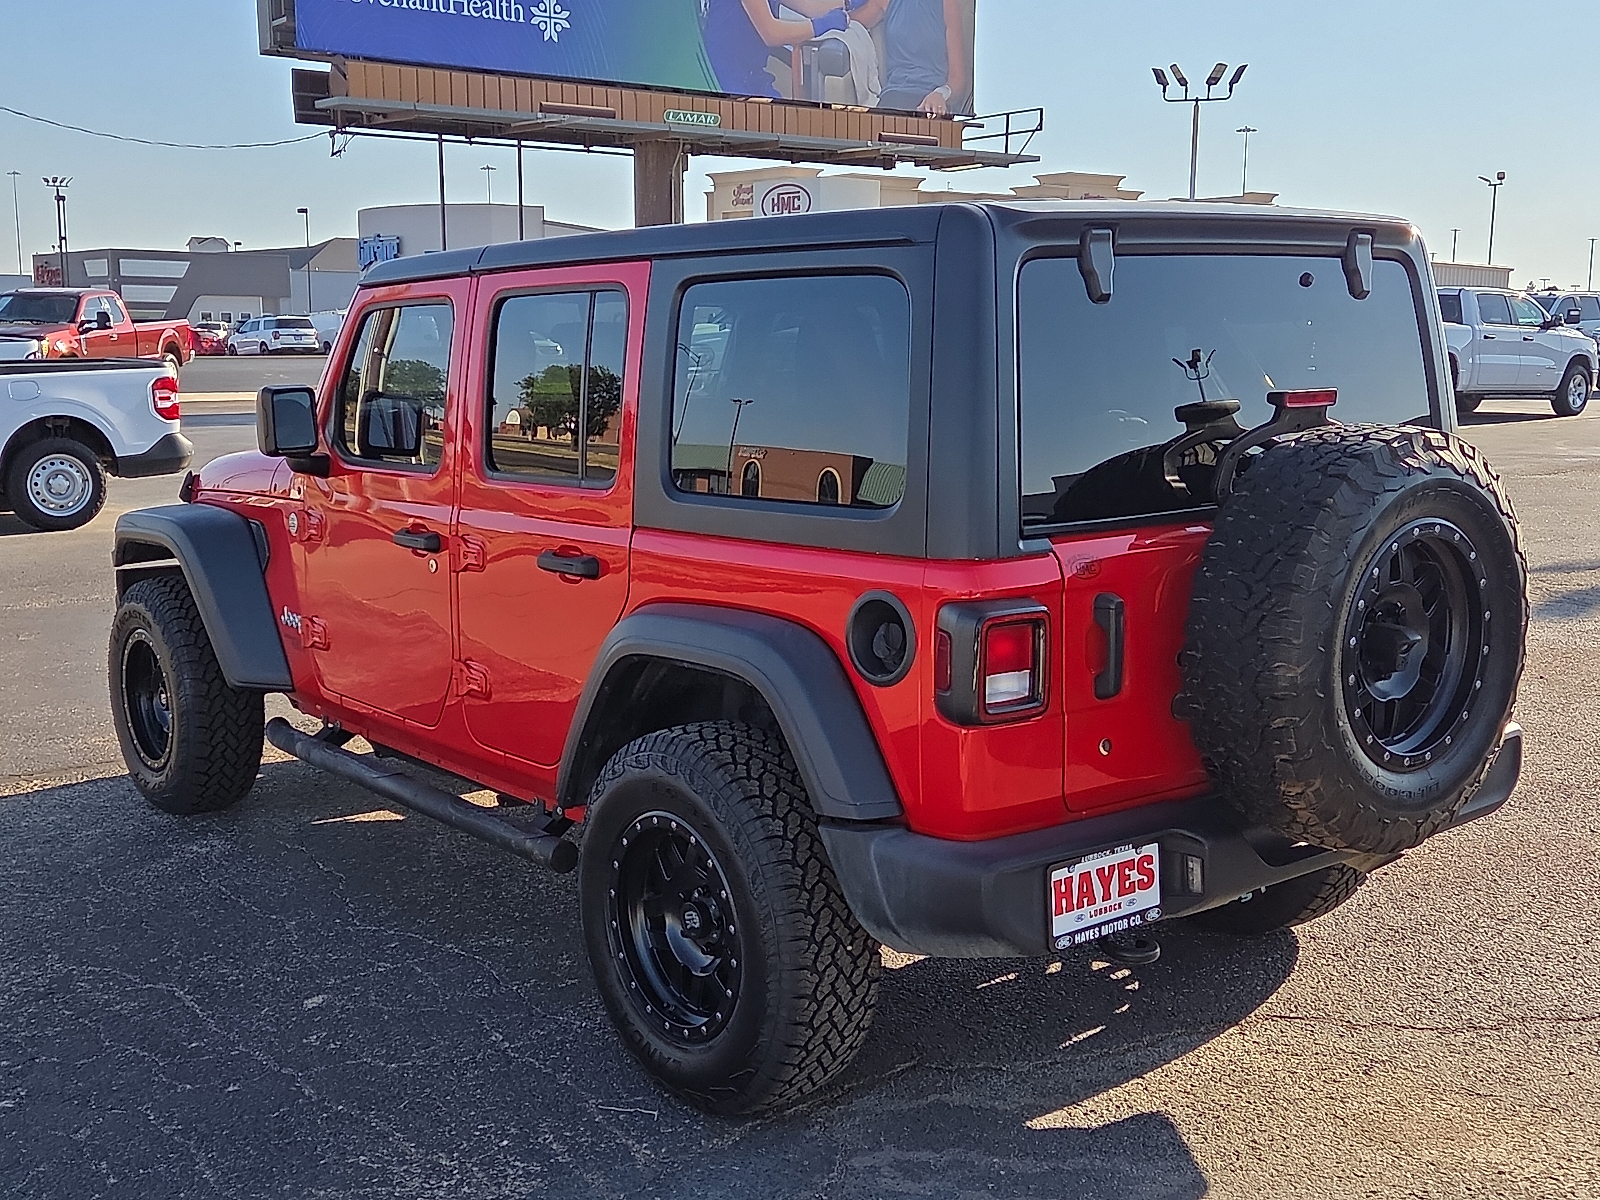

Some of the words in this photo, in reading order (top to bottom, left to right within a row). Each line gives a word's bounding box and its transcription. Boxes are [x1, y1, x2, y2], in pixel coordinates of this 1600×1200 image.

[668, 111, 715, 124] LAMAR
[770, 190, 801, 215] HMC
[1114, 843, 1133, 854] TEXAS
[1053, 853, 1156, 917] HAYES
[1088, 902, 1123, 919] LUBBOCK
[1074, 927, 1100, 944] HAYES
[1101, 918, 1129, 936] MOTOR
[1129, 914, 1143, 927] CO.
